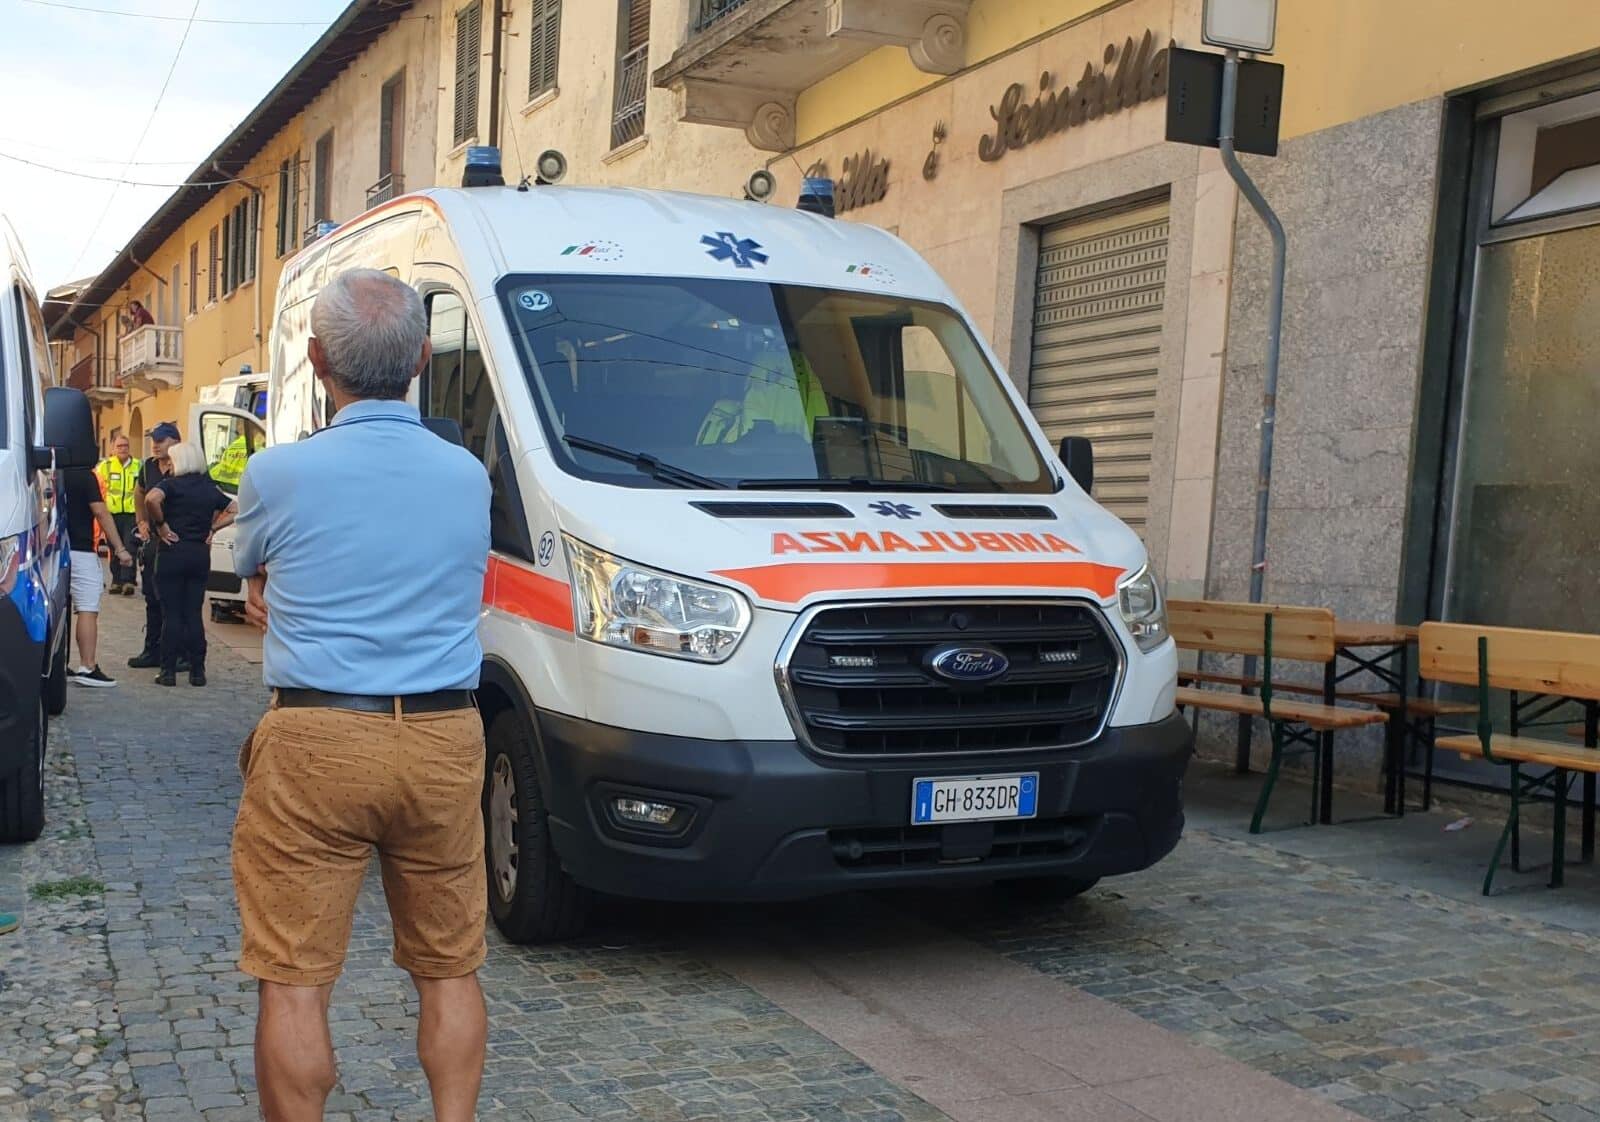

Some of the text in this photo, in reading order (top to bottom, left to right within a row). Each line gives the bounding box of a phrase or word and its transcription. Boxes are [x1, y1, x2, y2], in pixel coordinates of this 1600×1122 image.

[978, 28, 1176, 163] Scintilla
[522, 293, 548, 308] 92
[540, 538, 552, 560] 92
[953, 653, 993, 673] Ford
[934, 788, 957, 813] GH
[963, 785, 1019, 811] 833DR
